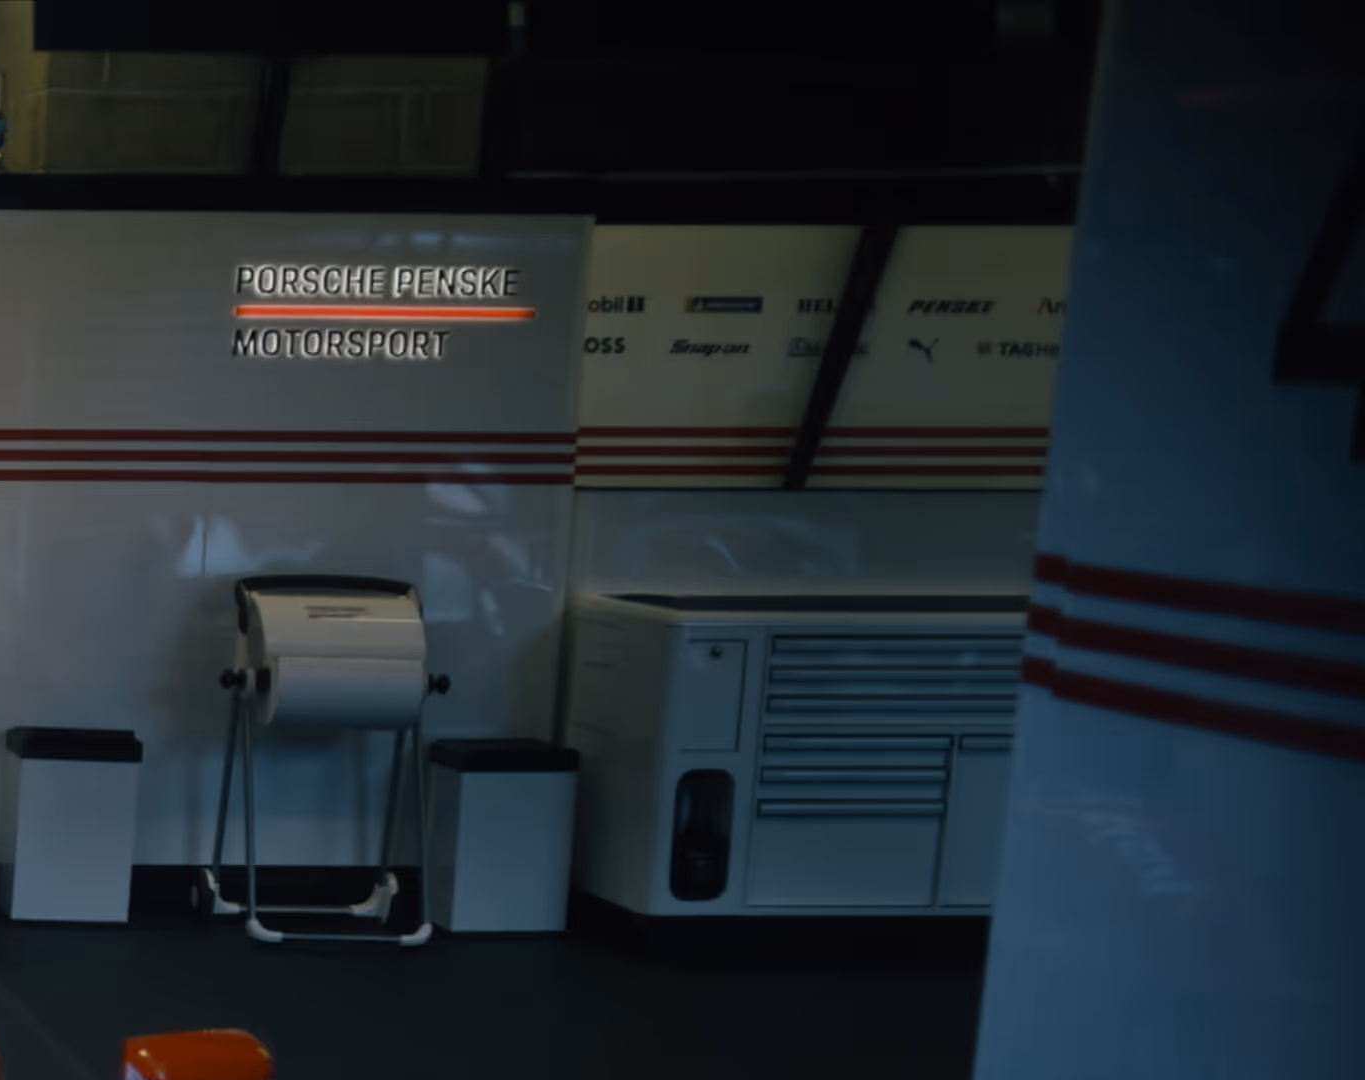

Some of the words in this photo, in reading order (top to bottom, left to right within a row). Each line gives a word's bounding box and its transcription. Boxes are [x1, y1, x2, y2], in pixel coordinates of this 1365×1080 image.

[236, 264, 386, 297] PORSCHE
[392, 266, 522, 299] PENSKE
[587, 296, 623, 313] obil
[232, 327, 450, 359] MOTORSPORT
[584, 337, 627, 354] OSS
